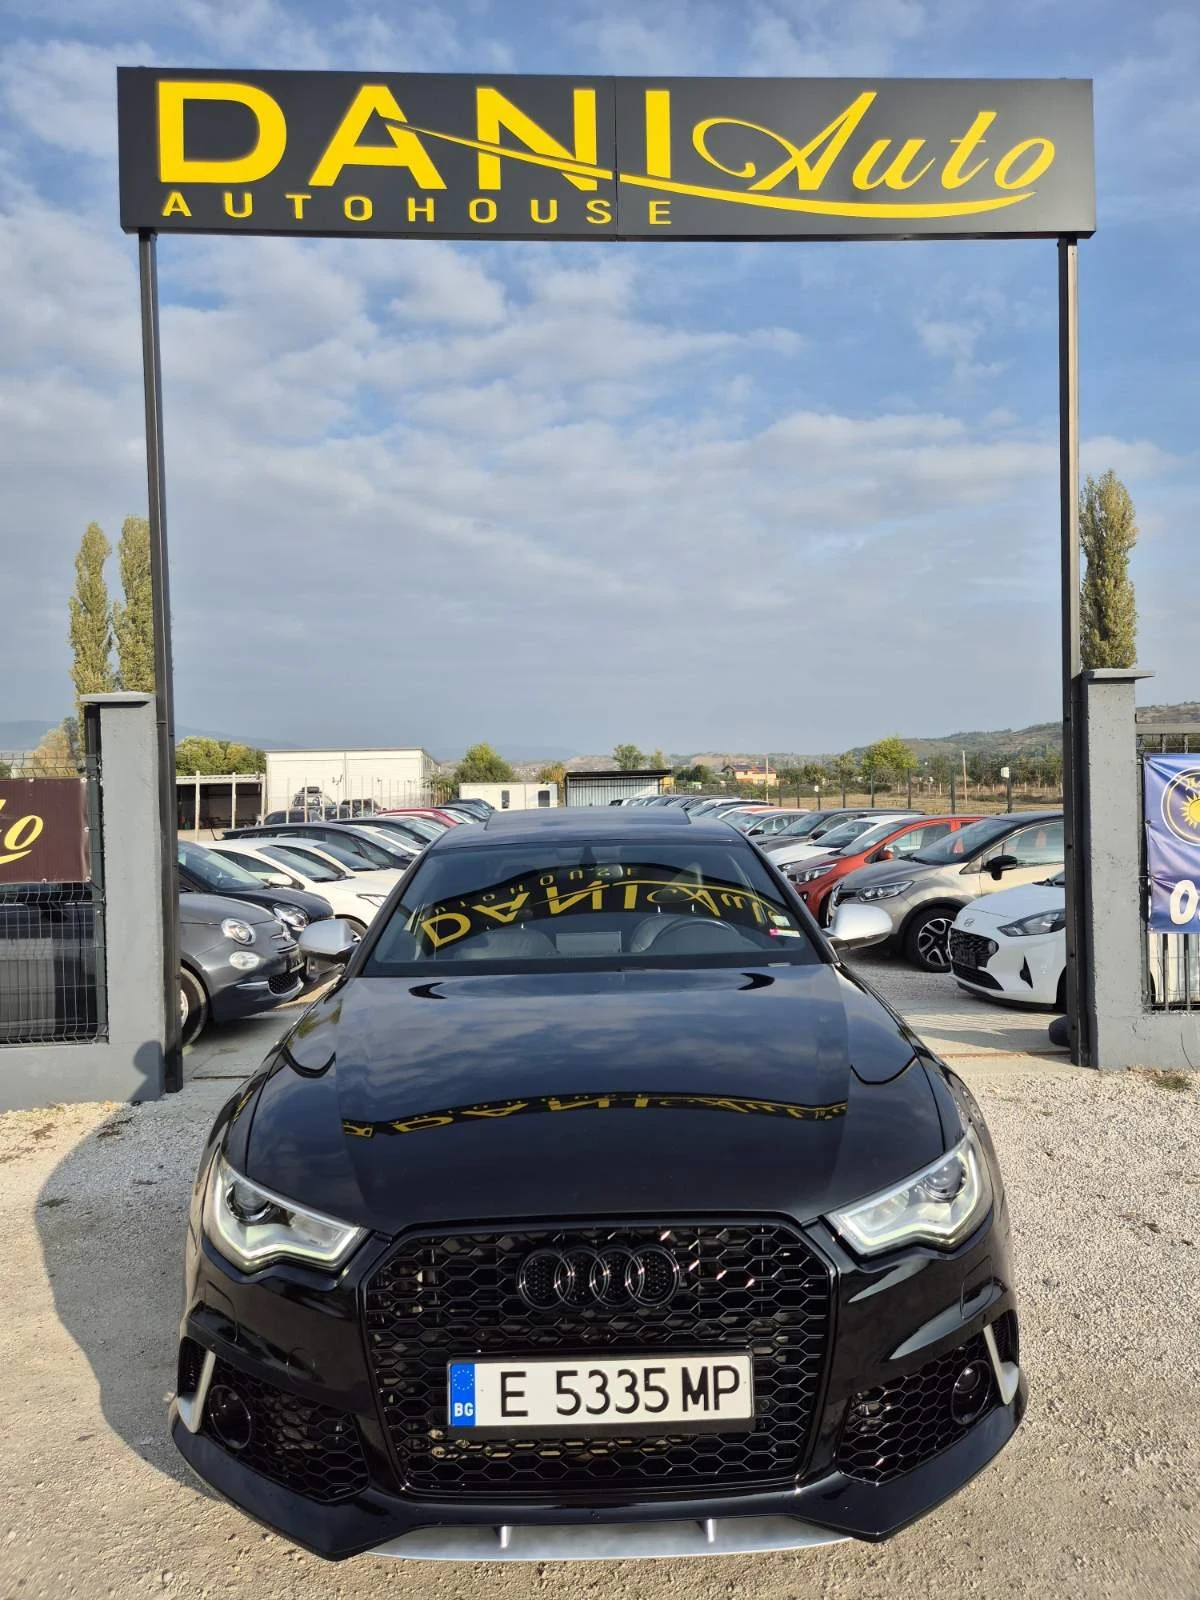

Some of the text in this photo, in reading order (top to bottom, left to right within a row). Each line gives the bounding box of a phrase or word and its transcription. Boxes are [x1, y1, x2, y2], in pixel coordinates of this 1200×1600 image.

[158, 81, 1056, 192] DANI Auto
[162, 191, 672, 226] AUTOHOUSE
[454, 1402, 474, 1417] BG
[500, 1364, 741, 1417] E 5335 MP
